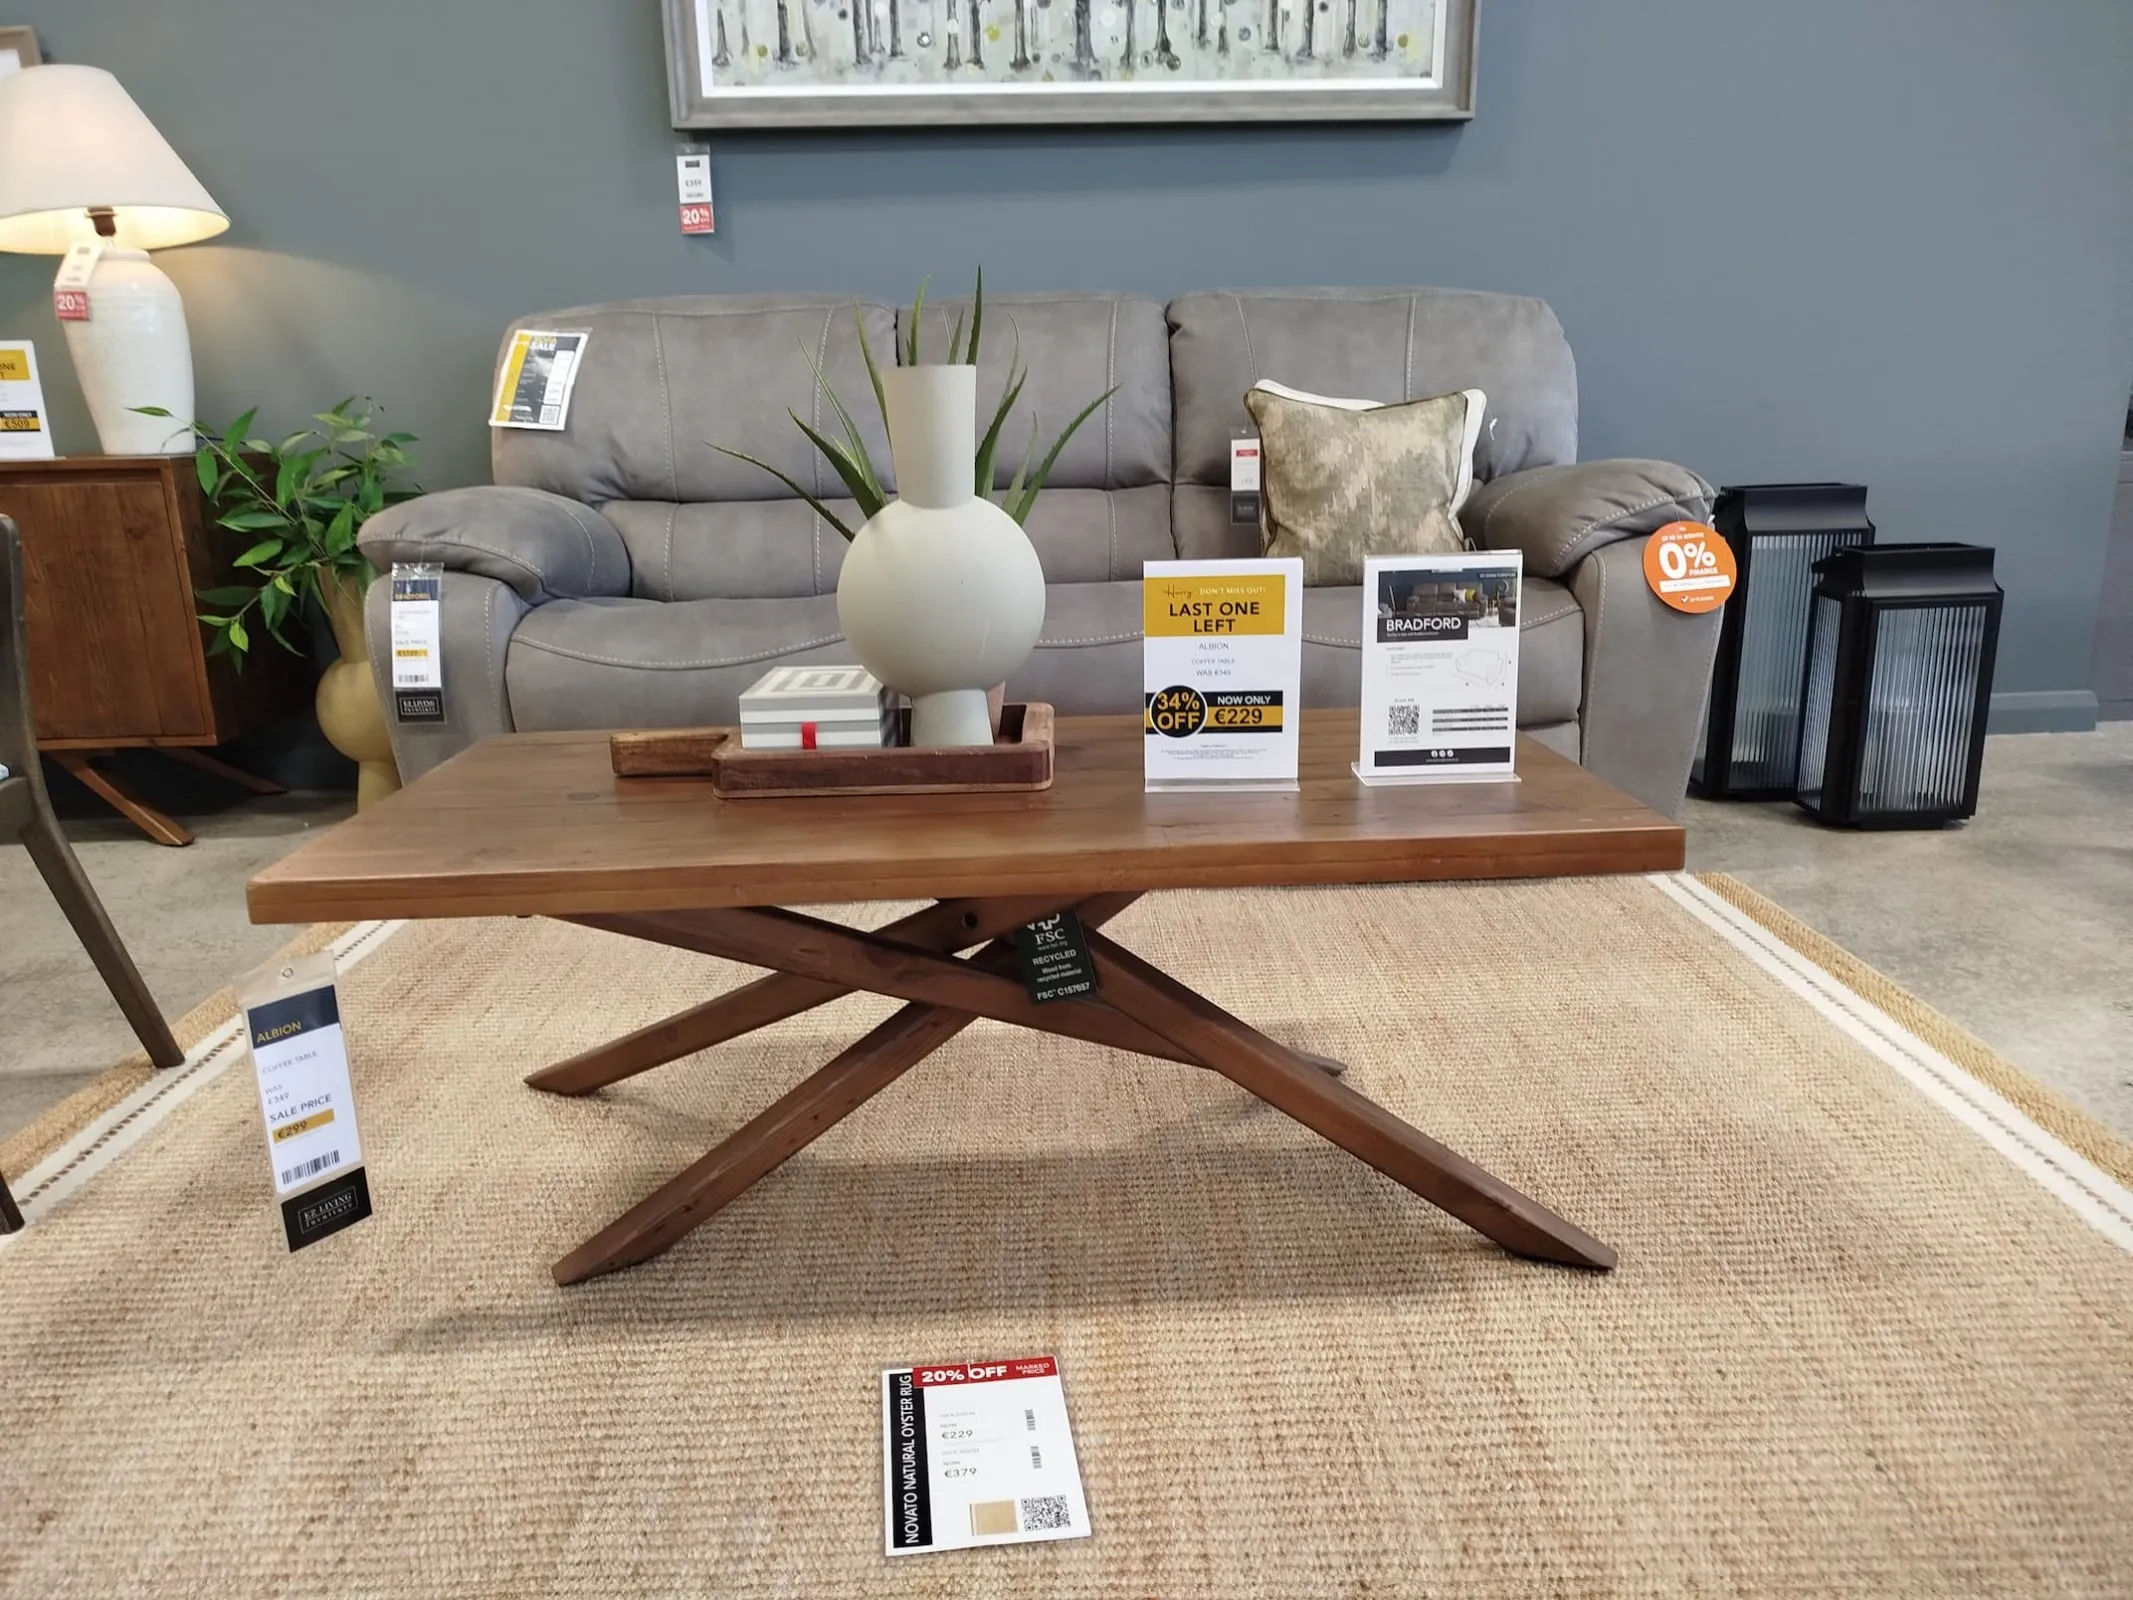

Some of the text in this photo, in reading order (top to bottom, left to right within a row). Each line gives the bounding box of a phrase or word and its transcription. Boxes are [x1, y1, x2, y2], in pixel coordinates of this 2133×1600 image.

[682, 207, 710, 225] 20%
[1659, 541, 1716, 579] 0%
[1169, 602, 1260, 616] LAST ONE
[1194, 619, 1236, 632] LEFT
[1386, 617, 1461, 632] BRADFORD
[1199, 642, 1229, 651] ALBION
[1157, 692, 1200, 710] 34%
[1217, 695, 1271, 705] NOW ONLY
[1157, 712, 1200, 730] OFF
[1215, 708, 1262, 725] €229
[1034, 928, 1066, 945] FSC
[1032, 949, 1077, 966] RECYCLED
[257, 1020, 302, 1043] ALBION
[262, 1050, 318, 1075] COFFEE TABLE
[269, 1092, 333, 1123] SALE PRICE
[278, 1120, 308, 1139] €299
[319, 1192, 352, 1213] LIVING
[921, 1363, 1050, 1383] 20% OFF MARKED
[1021, 1368, 1045, 1376] PRICE
[941, 1430, 973, 1440] €229
[899, 1375, 919, 1544] NOVATO NATURAL OYSTER RUG
[944, 1467, 977, 1479] €379
